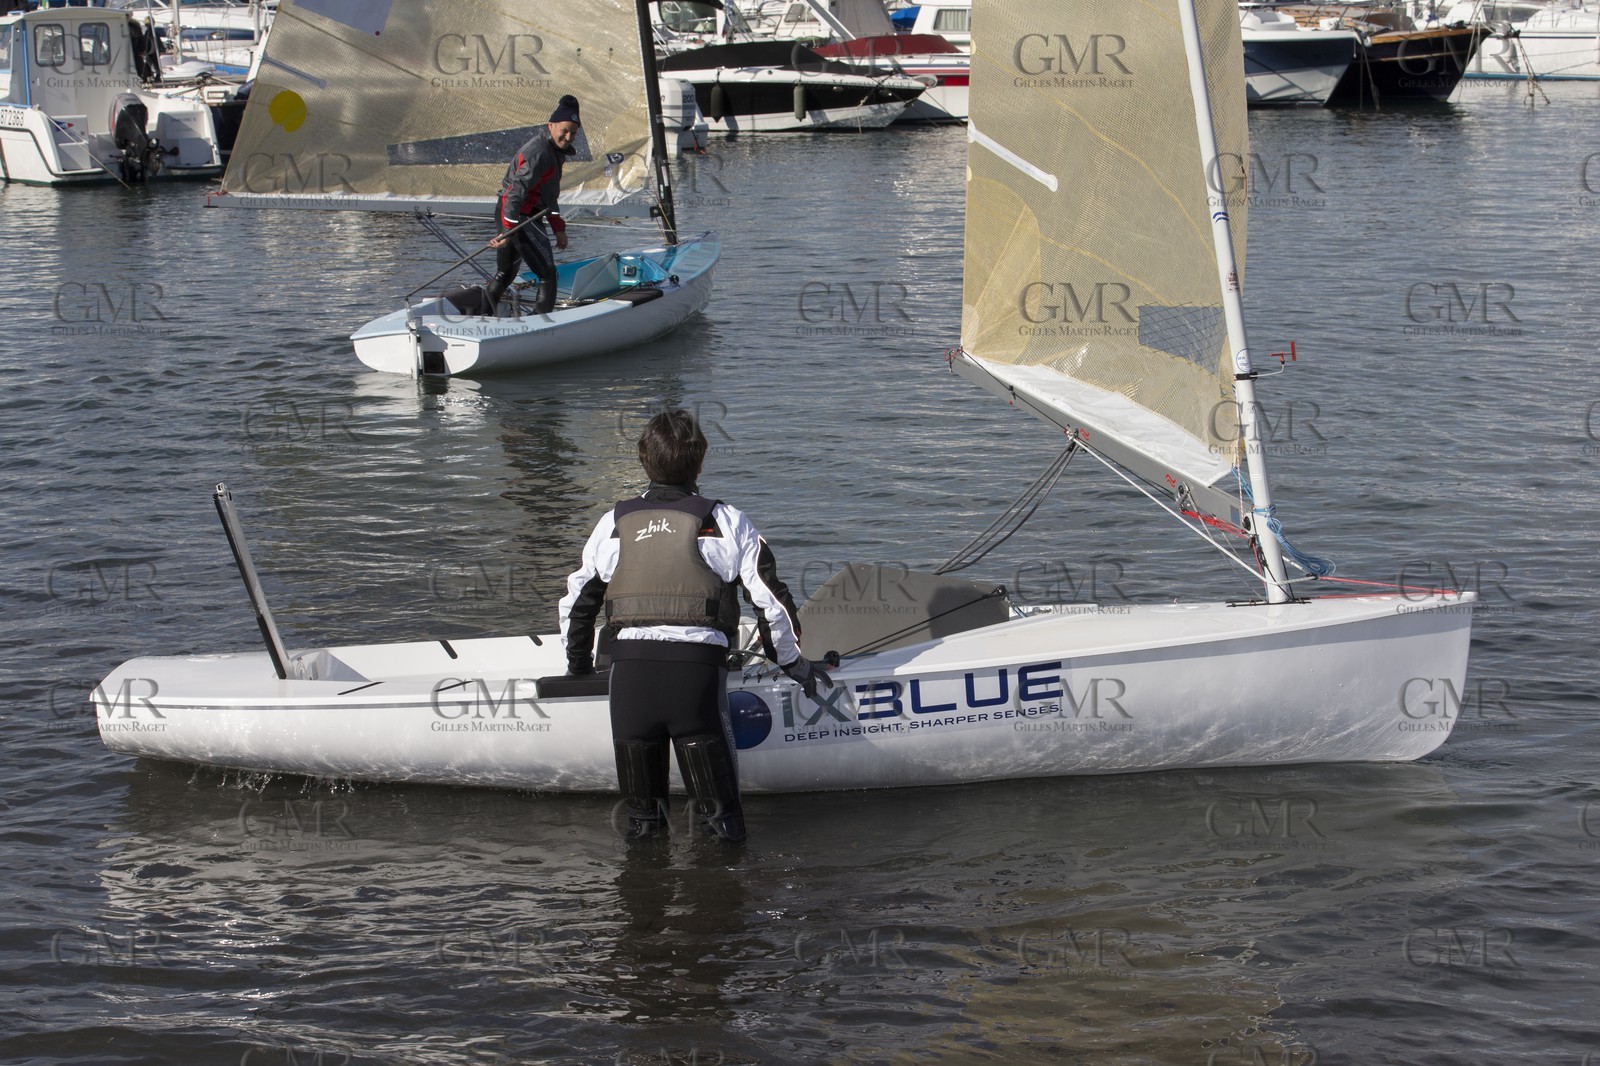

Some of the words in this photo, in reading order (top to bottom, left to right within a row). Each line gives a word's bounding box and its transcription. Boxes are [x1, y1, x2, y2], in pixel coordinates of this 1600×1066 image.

[683, 94, 695, 104] 200
[784, 730, 830, 742] DEEP
[834, 723, 905, 738] INSIGHT.
[909, 713, 988, 729] SHARPER
[993, 704, 1063, 720] SENSES.
